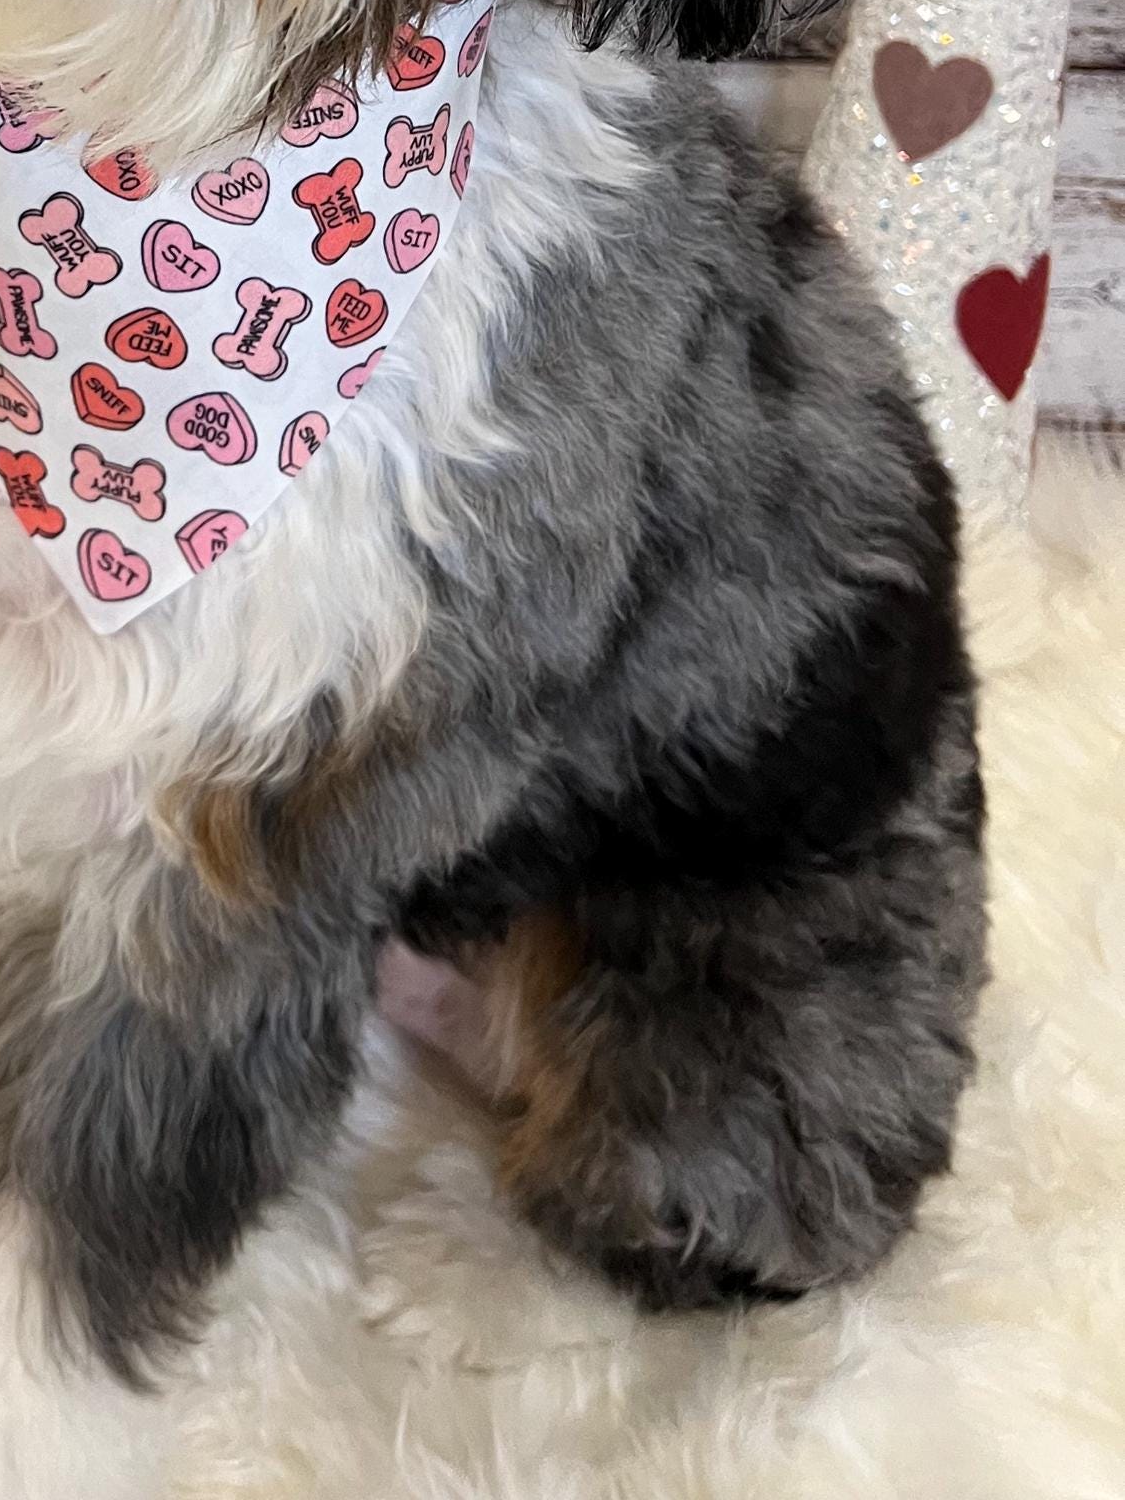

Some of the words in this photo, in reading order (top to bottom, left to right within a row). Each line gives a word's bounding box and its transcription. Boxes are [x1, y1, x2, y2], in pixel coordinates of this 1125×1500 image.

[292, 102, 345, 130] SNIFF
[409, 133, 434, 150] LUV
[399, 146, 435, 169] PUPPY
[209, 171, 263, 206] XOXO
[319, 195, 343, 229] YOU
[336, 185, 360, 225] WUFF
[41, 232, 79, 273] WUFF
[59, 229, 90, 263] YOU
[400, 228, 432, 249] SIT
[161, 243, 207, 280] SIT
[337, 292, 372, 321] FEED
[143, 319, 172, 339] ME
[236, 294, 281, 357] PAWSOME
[330, 312, 356, 336] ME
[128, 333, 173, 357] FEED
[86, 377, 132, 416] SNIFF
[194, 402, 230, 429] DOG
[184, 418, 230, 448] GOOD
[90, 477, 142, 504] PUPPY
[102, 469, 135, 487] LUV
[97, 552, 139, 586] SIT
